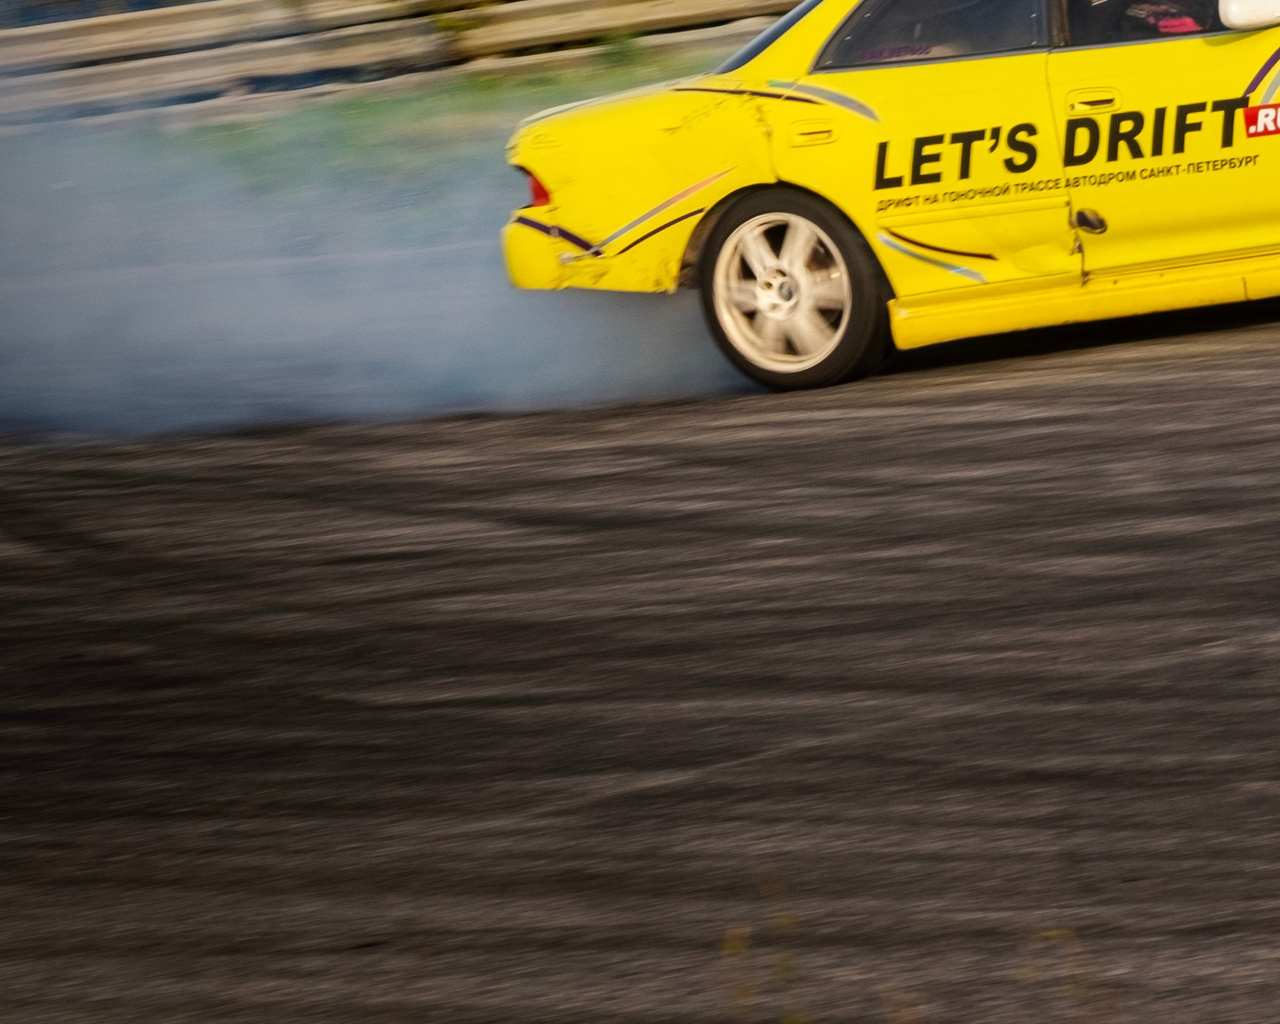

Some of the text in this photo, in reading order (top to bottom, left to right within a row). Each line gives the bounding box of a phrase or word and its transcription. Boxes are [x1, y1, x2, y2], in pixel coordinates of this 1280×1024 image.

[1063, 96, 1250, 168] DRIFT
[876, 154, 1260, 212] ДРИФТ НА ГОНОЧНОЙ ТРАССЕ АВТОДРОМ САНКТ-ПЕТЕРБУРГ
